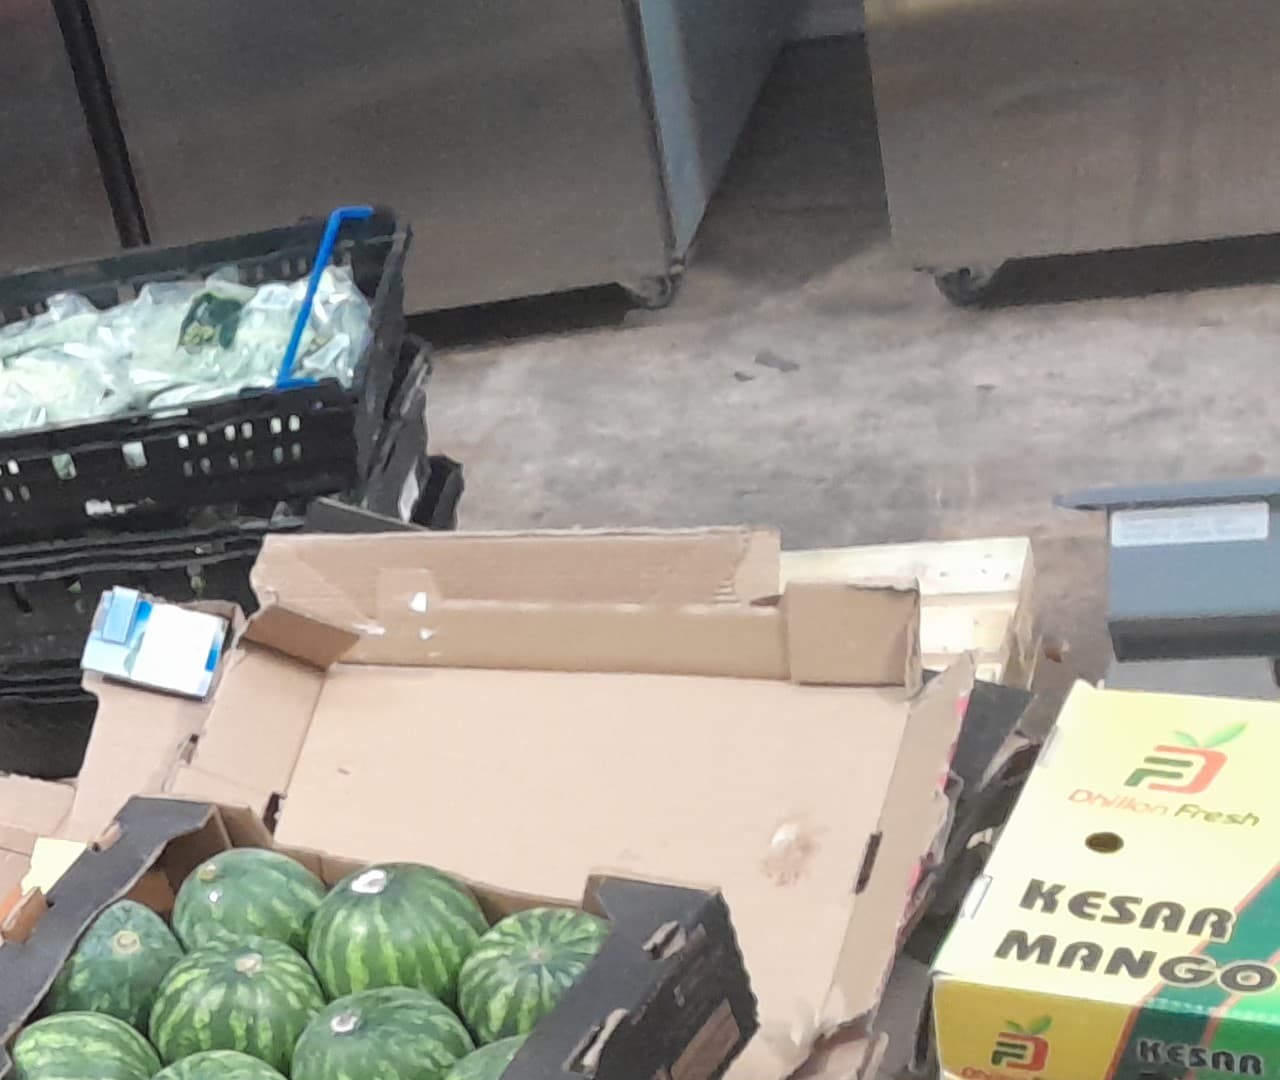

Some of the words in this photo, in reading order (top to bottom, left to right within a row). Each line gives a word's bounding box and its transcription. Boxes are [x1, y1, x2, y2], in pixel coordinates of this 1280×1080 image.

[1068, 788, 1169, 816] Dhillon
[1174, 803, 1260, 827] Fresh
[1018, 878, 1235, 942] KESAR
[993, 929, 1278, 994] MANGO
[1137, 1038, 1264, 1077] KESAR
